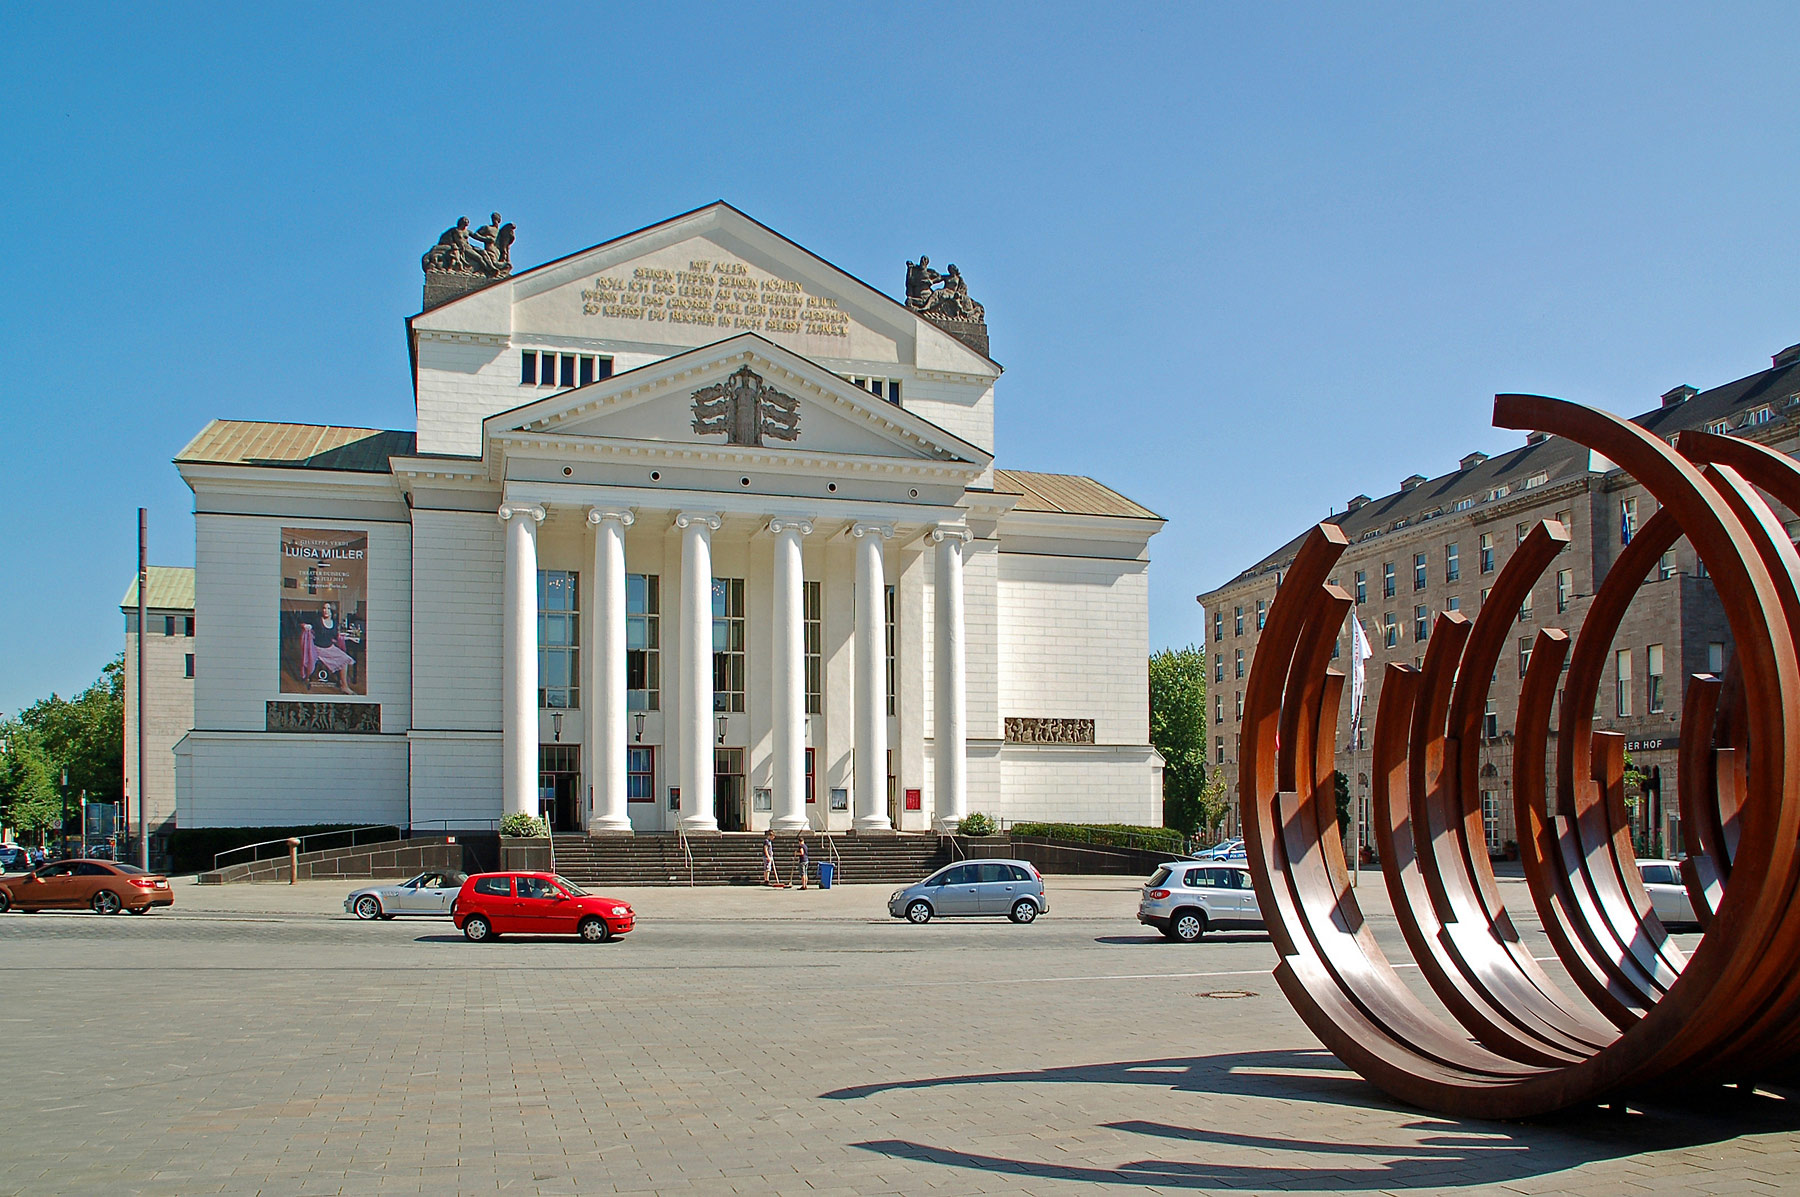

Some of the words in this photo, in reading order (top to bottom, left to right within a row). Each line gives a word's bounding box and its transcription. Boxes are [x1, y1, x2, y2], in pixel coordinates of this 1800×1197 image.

[633, 267, 674, 282] SEINEN
[719, 276, 759, 290] SEINEN
[712, 262, 749, 276] ALLEN
[628, 279, 650, 293] ICH
[653, 281, 676, 295] DAS
[761, 293, 803, 307] DEINEM
[806, 296, 838, 309] BLICK
[583, 302, 601, 315] SO
[648, 308, 667, 321] DU
[621, 292, 639, 305] DU
[641, 294, 665, 307] DAS
[744, 304, 768, 317] DER
[769, 307, 798, 319] WELT
[800, 310, 850, 324] GESEHEN
[285, 546, 319, 558] LUISA
[321, 548, 363, 559] MILLER
[1643, 739, 1662, 749] HOF
